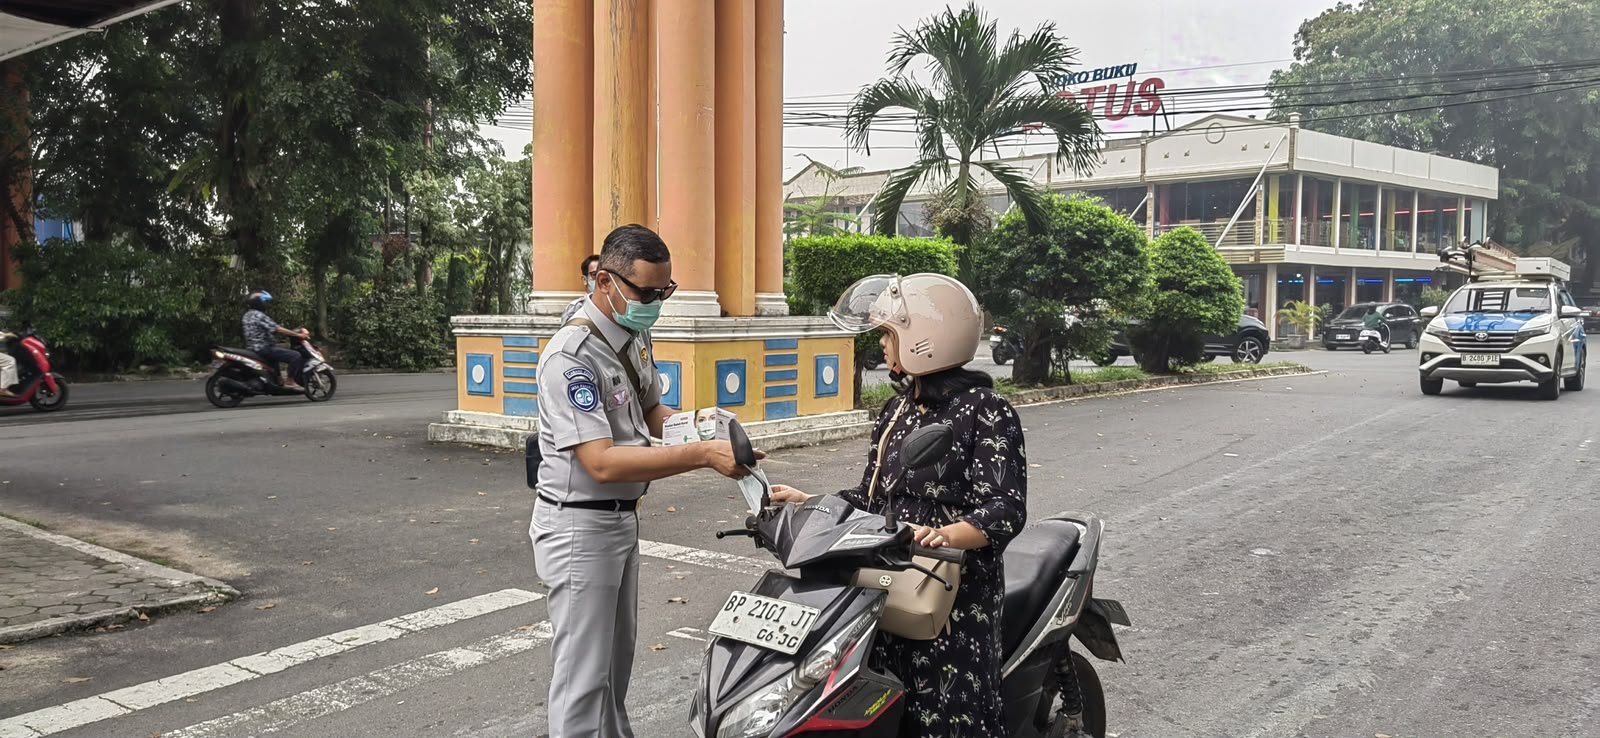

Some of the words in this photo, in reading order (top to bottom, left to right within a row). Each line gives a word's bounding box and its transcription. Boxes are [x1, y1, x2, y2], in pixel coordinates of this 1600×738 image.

[1092, 62, 1138, 82] BUKU
[804, 505, 831, 514] HONDA
[724, 595, 747, 612] BP
[791, 610, 816, 629] JT
[828, 686, 858, 713] HONDA
